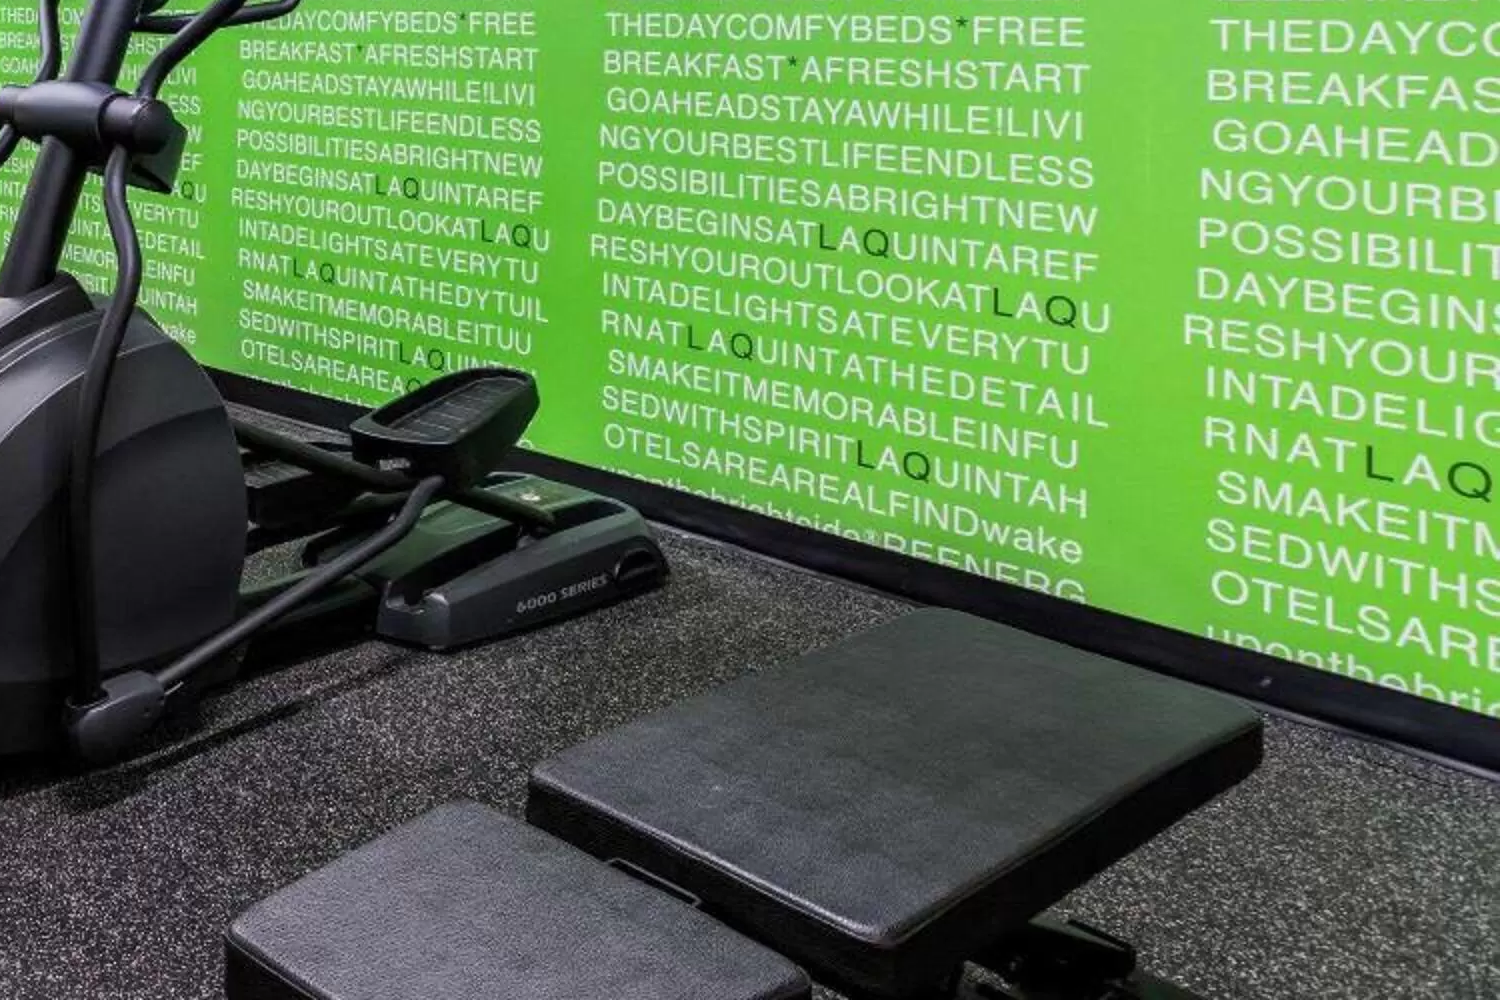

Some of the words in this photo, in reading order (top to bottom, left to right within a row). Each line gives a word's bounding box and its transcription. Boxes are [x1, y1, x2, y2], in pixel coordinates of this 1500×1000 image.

[598, 160, 1096, 237] POSSIBILITIESABRIGHTNEW
[599, 123, 1093, 189] NGYOURBESTLIFEENDLESS
[1200, 167, 1500, 224] NGYOURB
[590, 232, 1110, 333] RESHYOUROUTLOOKATLAQU
[597, 196, 1097, 285] DAYBEGINSATLAQUINTAREF
[603, 270, 1089, 377] INTADELIGHTSATEVERYTU
[1196, 265, 1500, 336] DAYBEGIN
[601, 307, 1109, 428] RNATLAQUINTATHEDETAIL
[608, 347, 1078, 471] SMAKEITMEMORABLEINFU
[602, 383, 1086, 520] SEDWITHSPIRITLAQUINTAH
[604, 421, 1082, 567] OTELSAREAREALFINDwake
[515, 591, 557, 614] 6000
[560, 573, 609, 601] SERIES
